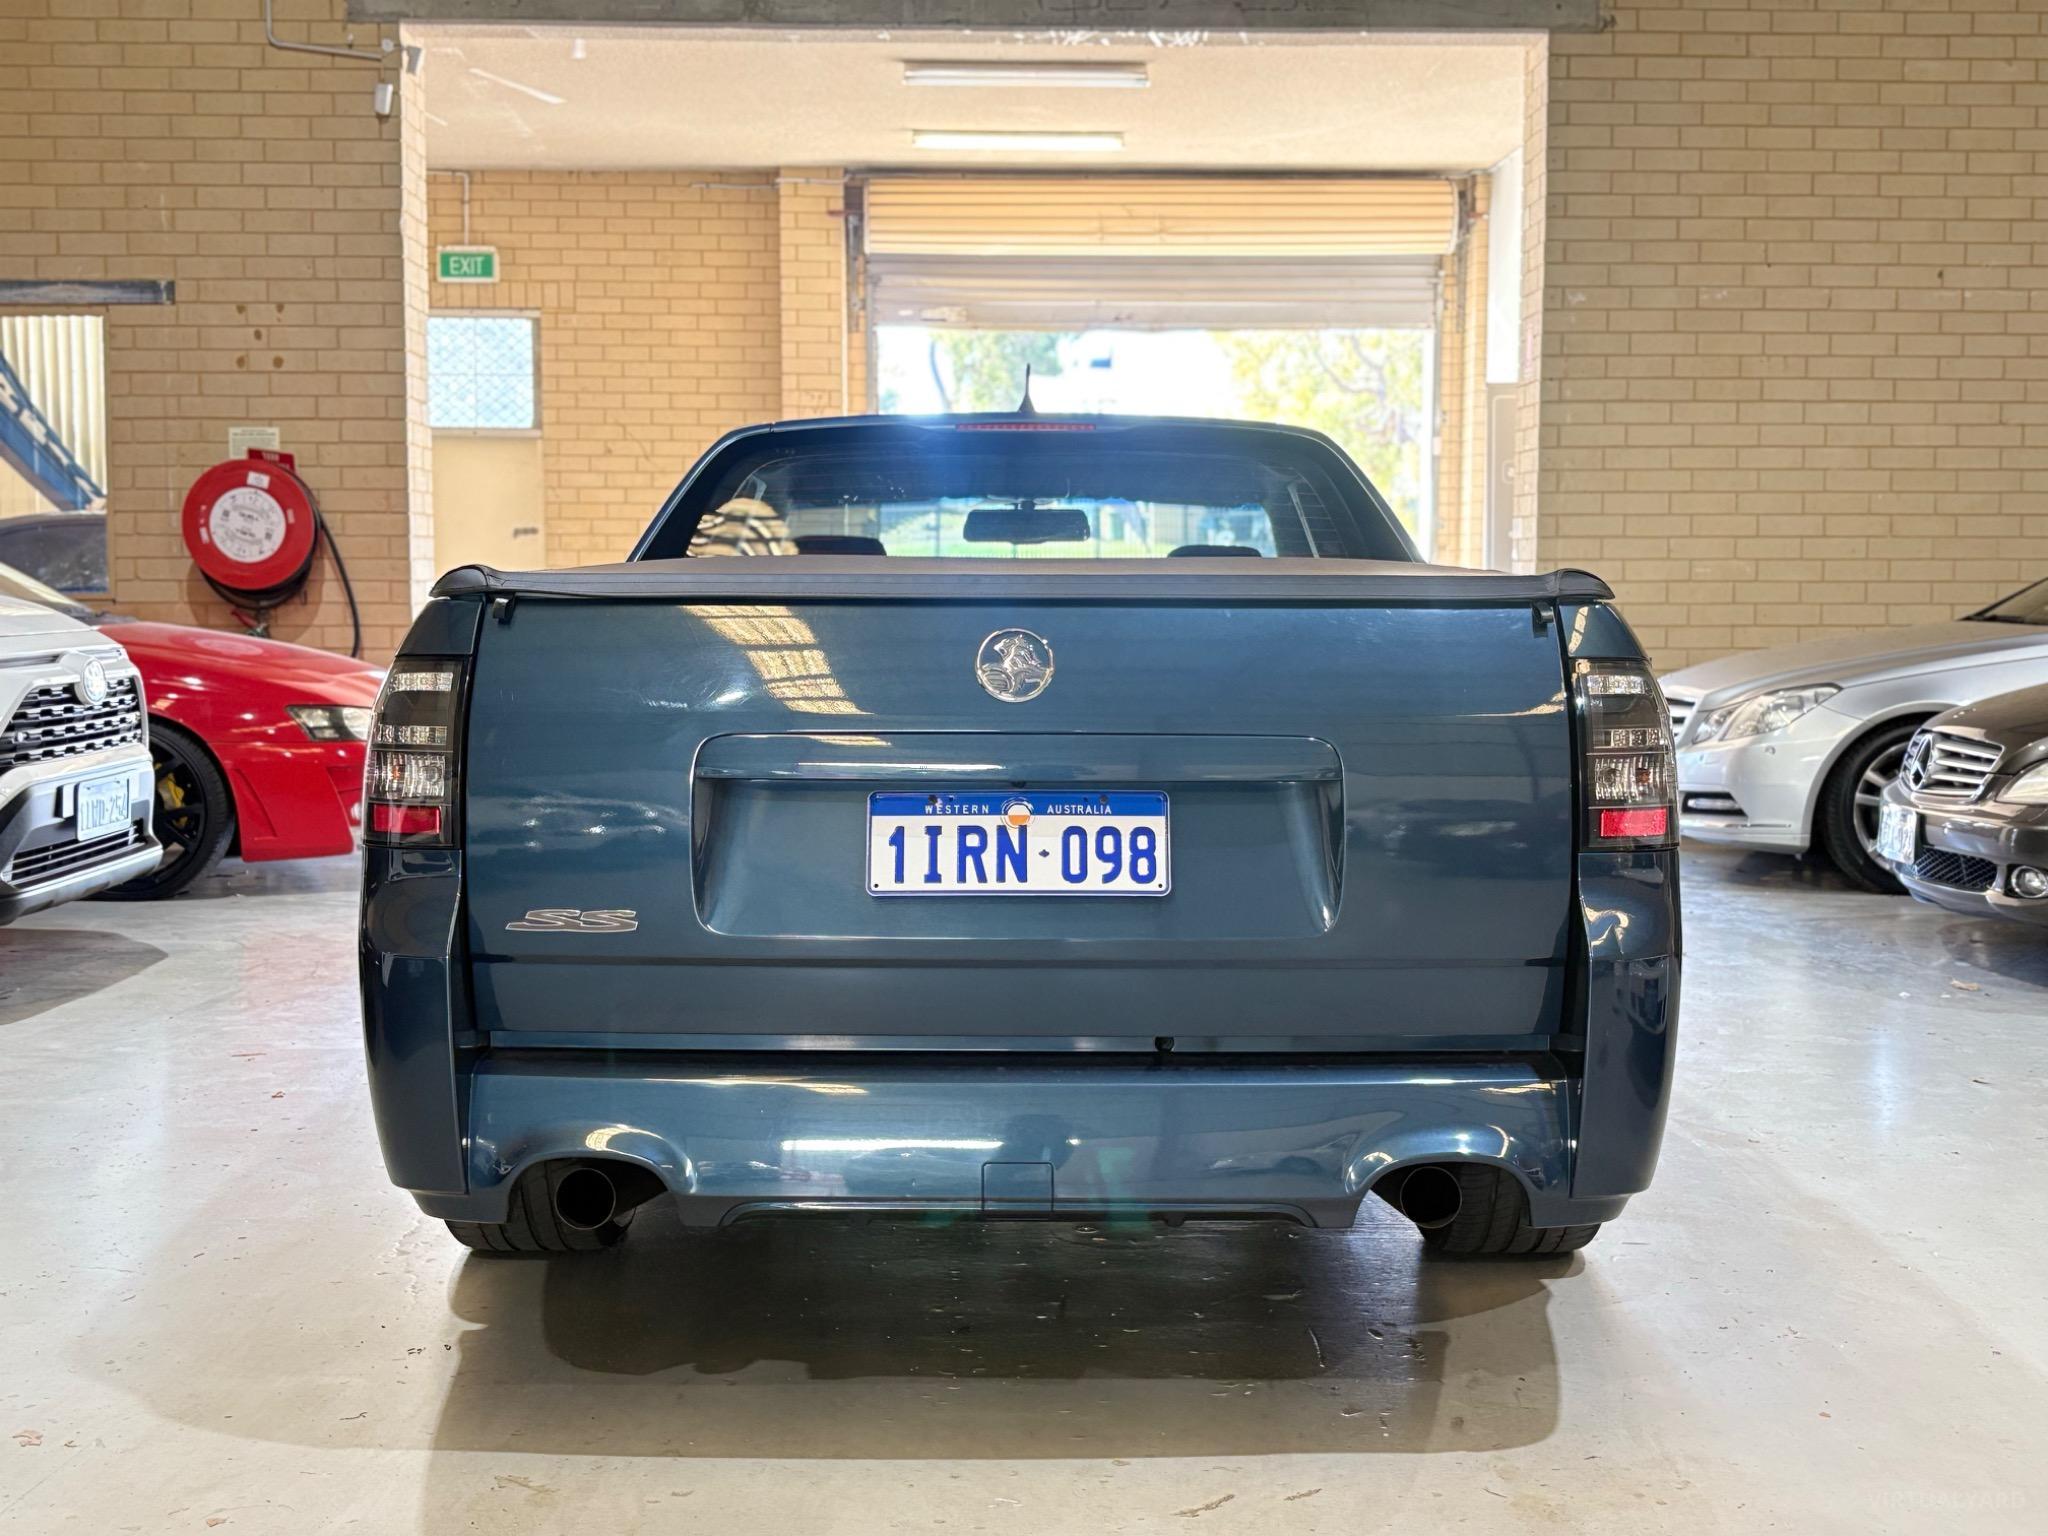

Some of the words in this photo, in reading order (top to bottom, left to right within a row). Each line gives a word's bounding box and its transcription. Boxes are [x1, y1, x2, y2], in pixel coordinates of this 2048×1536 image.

[449, 256, 485, 275] EXIT
[924, 804, 990, 815] WESTERN
[1046, 804, 1112, 815] AUSTRALIA
[505, 909, 639, 933] SS
